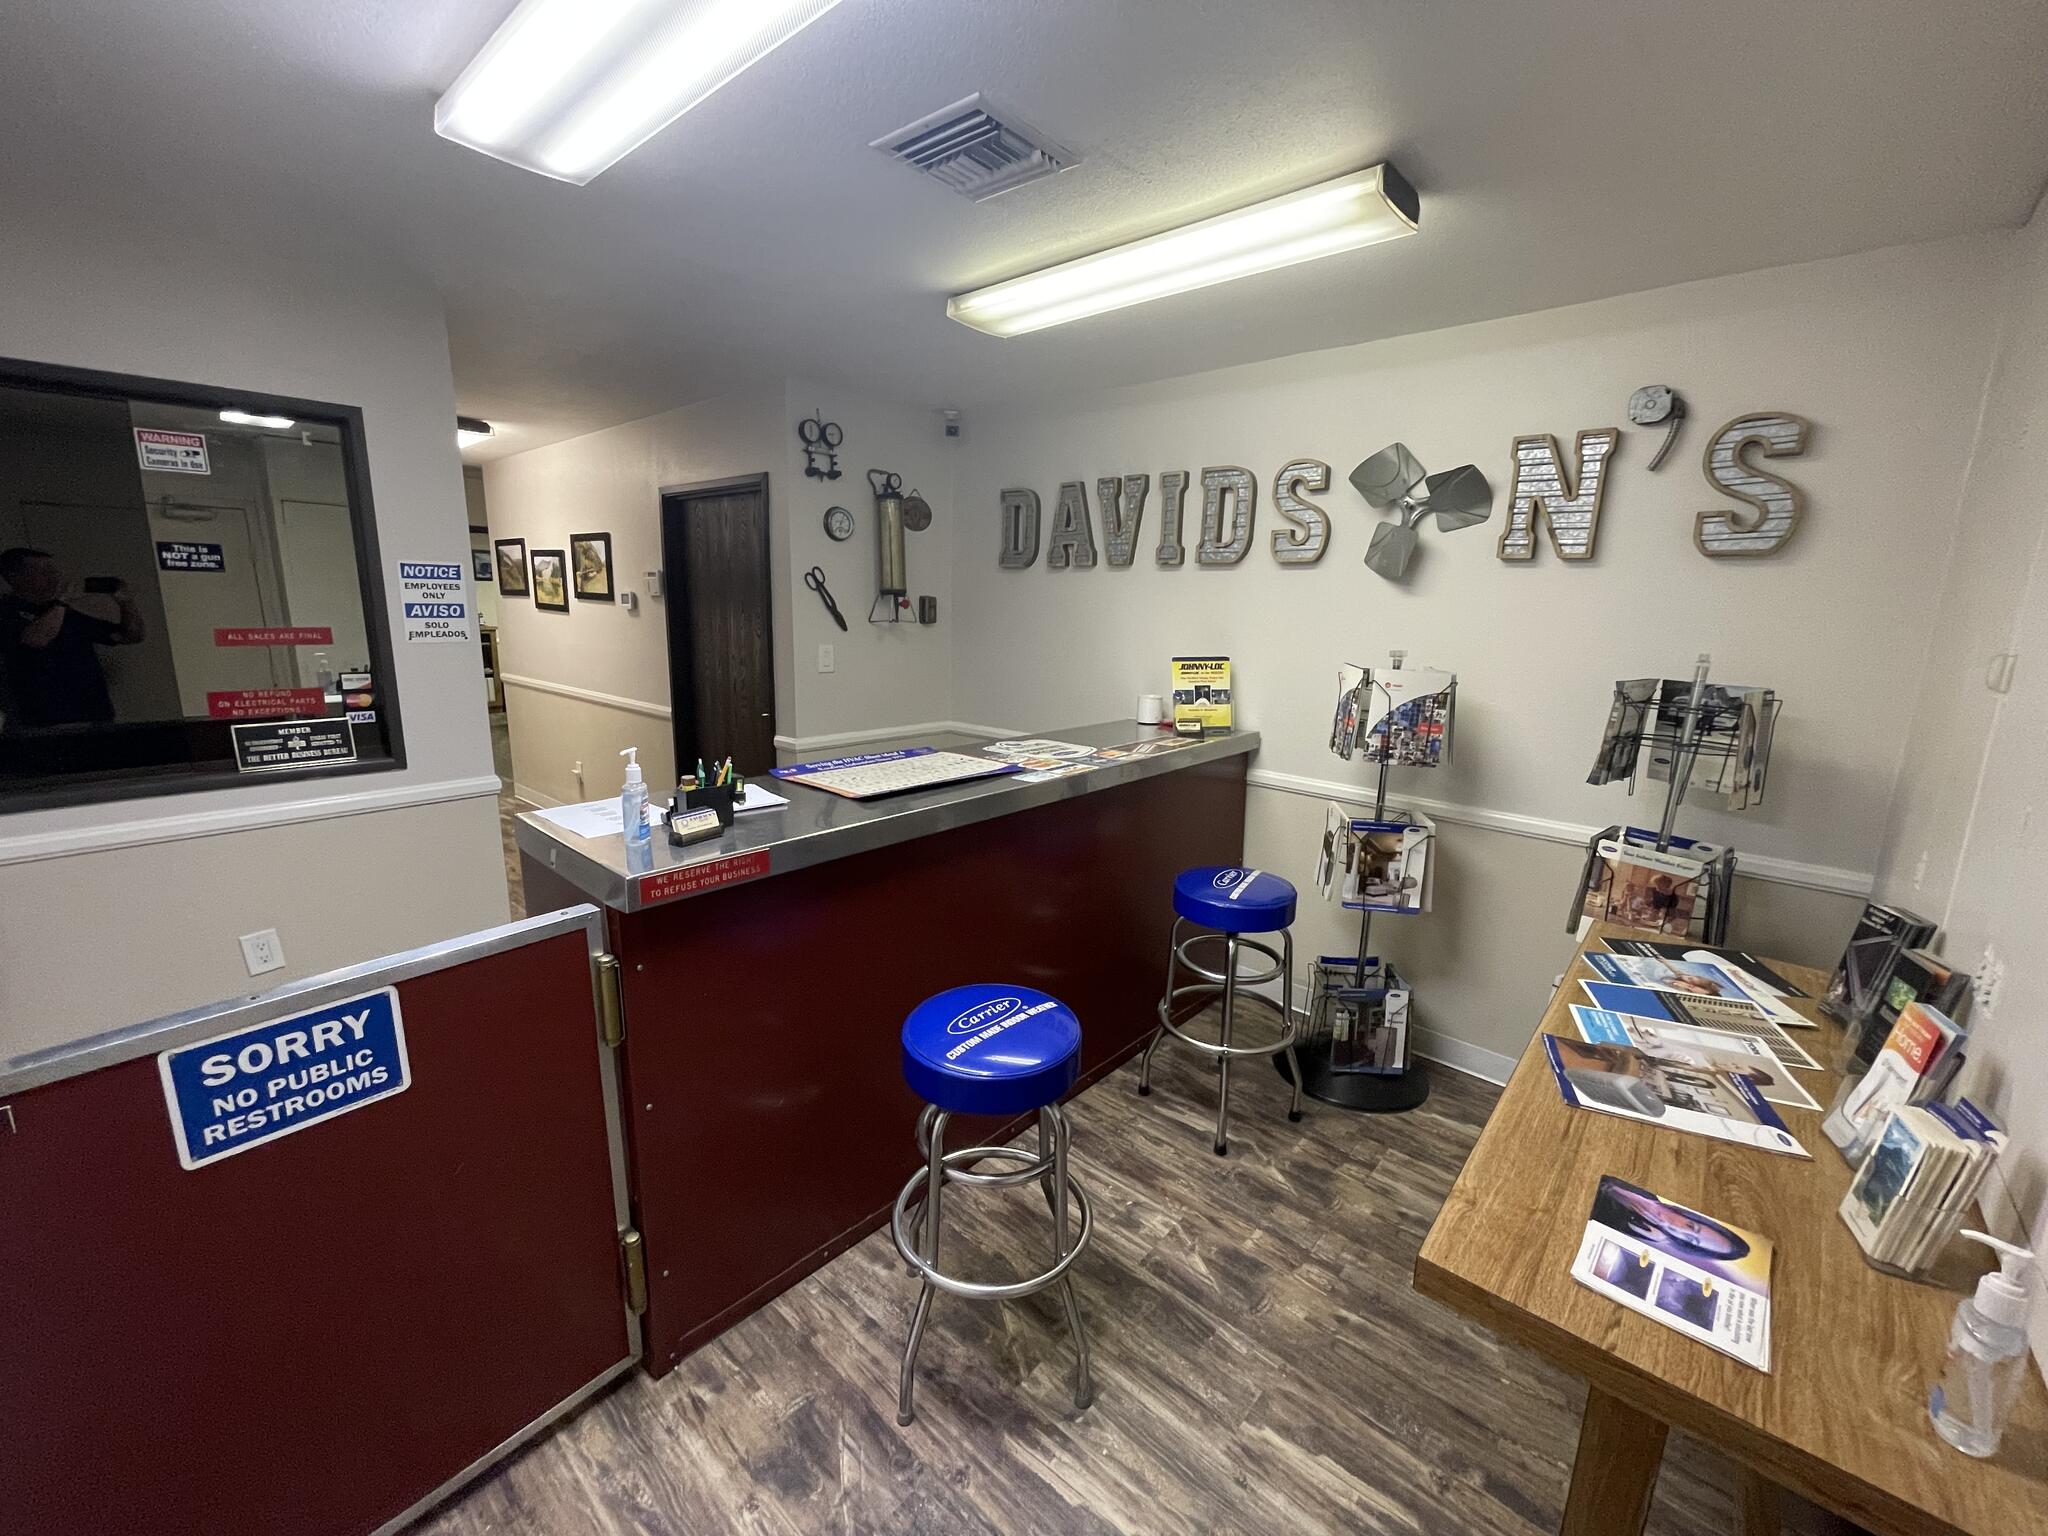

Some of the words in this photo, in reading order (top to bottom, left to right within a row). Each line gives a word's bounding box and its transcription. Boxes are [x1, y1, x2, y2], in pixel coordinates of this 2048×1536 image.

[141, 432, 201, 447] WARNING
[144, 445, 177, 457] Security
[146, 457, 179, 468] Cameras
[173, 544, 196, 553] This
[162, 552, 189, 560] NOT
[200, 554, 221, 563] gun
[167, 559, 188, 567] free
[403, 565, 458, 578] NOTICE
[404, 582, 461, 590] EMPLOYEES
[410, 604, 461, 616] AVISO
[424, 621, 449, 629] SOLO
[279, 632, 295, 640] ARE
[409, 630, 466, 638] EMPLEADOS
[234, 698, 287, 707] ELECTRICAL
[350, 713, 374, 721] VISA
[278, 727, 311, 735] MEMBER
[246, 755, 261, 763] THE
[263, 752, 290, 761] BETTER
[291, 749, 322, 759] BUSINESS
[655, 876, 668, 885] WE
[673, 865, 711, 881] RESERVE
[715, 862, 730, 870] THE
[650, 889, 661, 898] TO
[664, 881, 697, 895] REFUSE
[700, 876, 720, 886] YOUR
[722, 865, 761, 881] BUSINESS
[958, 1000, 1011, 1029] Carrier
[945, 1035, 983, 1060] CUSTOM
[978, 1024, 1005, 1040] MADE
[999, 1012, 1030, 1029] INDOOR
[1025, 1001, 1058, 1016] WEATHER
[200, 1008, 371, 1087] SORRY
[212, 1088, 258, 1117] NO
[267, 1049, 374, 1099] PUBLIC
[202, 1066, 389, 1146] RESTROOMS
